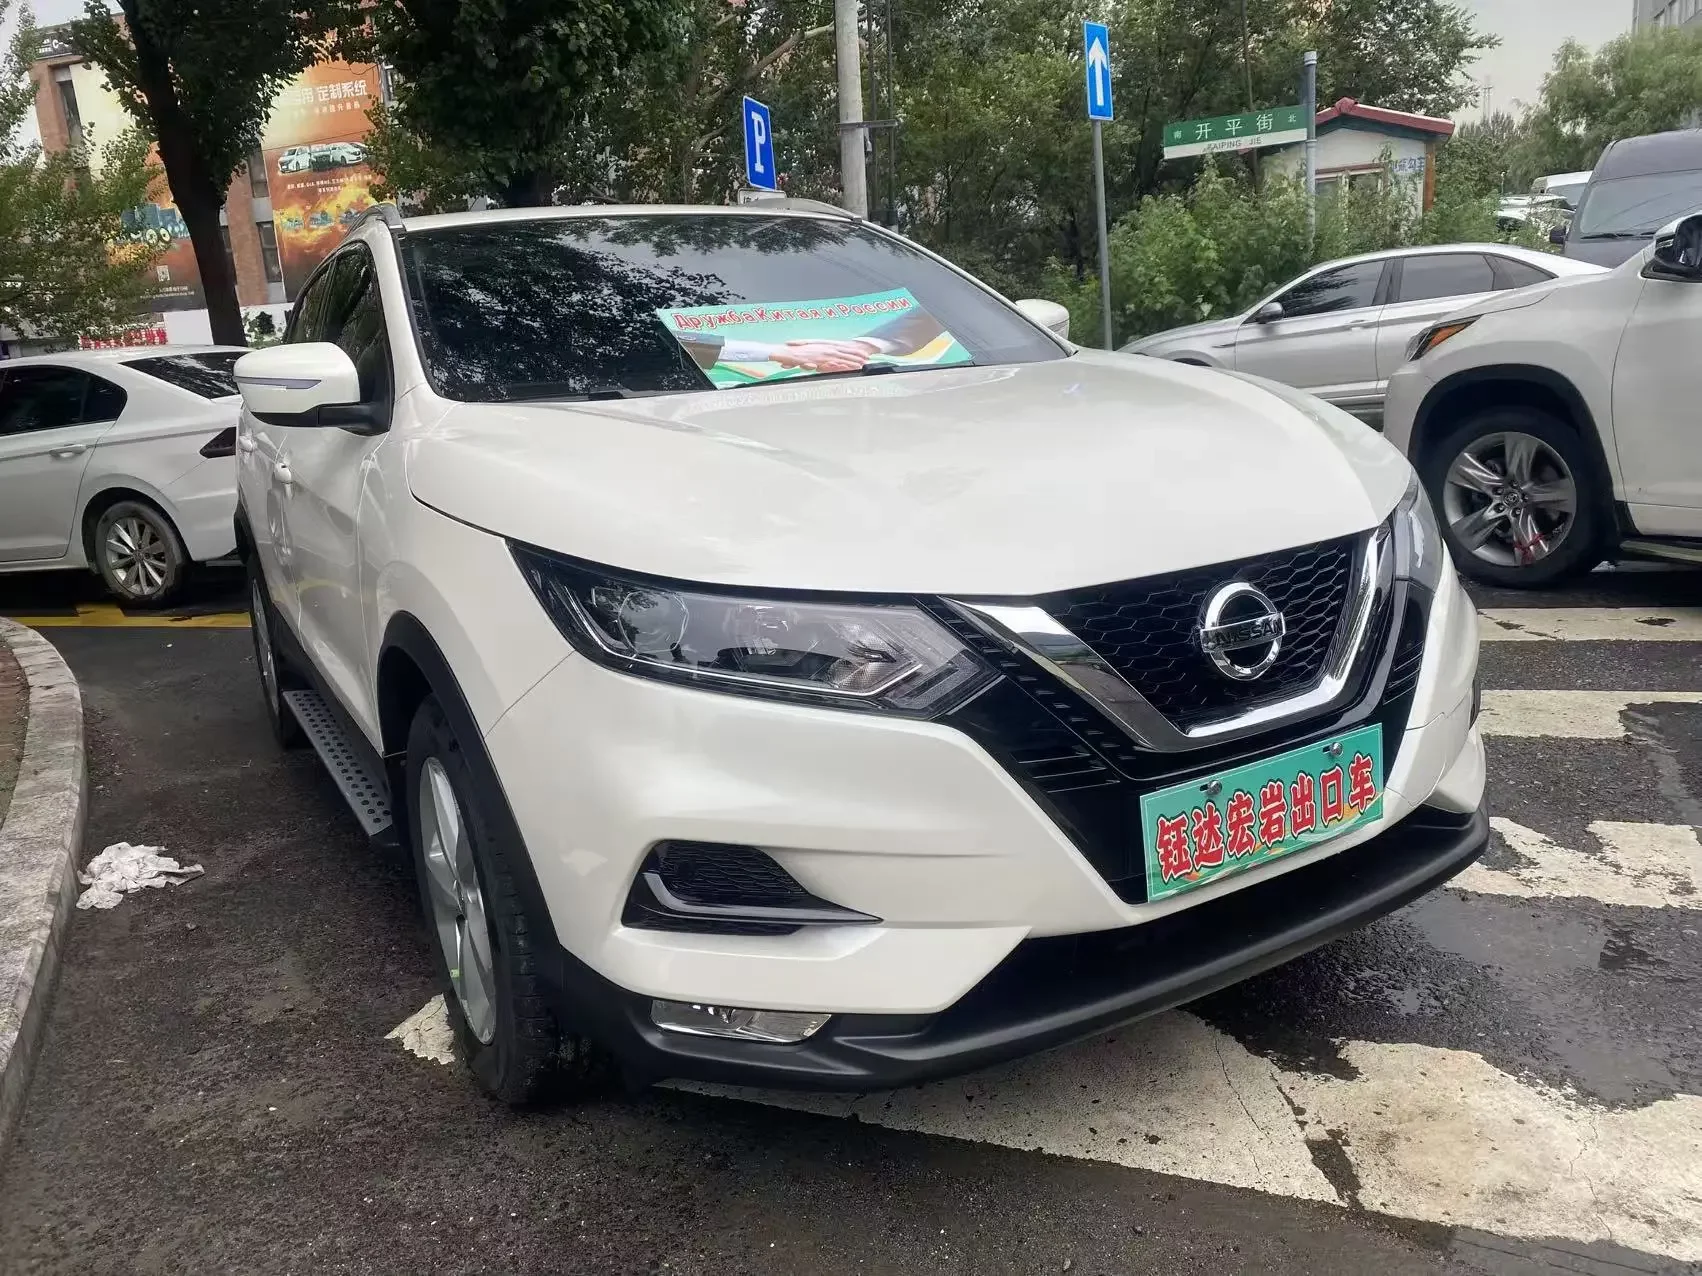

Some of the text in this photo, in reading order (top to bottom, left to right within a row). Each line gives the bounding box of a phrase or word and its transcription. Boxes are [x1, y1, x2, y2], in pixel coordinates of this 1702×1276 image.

[751, 111, 766, 174] P
[1195, 113, 1273, 140] 开平街
[1249, 137, 1262, 146] JIE
[672, 310, 755, 330] Дружба
[754, 308, 821, 322] Китая
[835, 297, 913, 316] России
[1156, 752, 1377, 884] 钰达宏岩出口车
